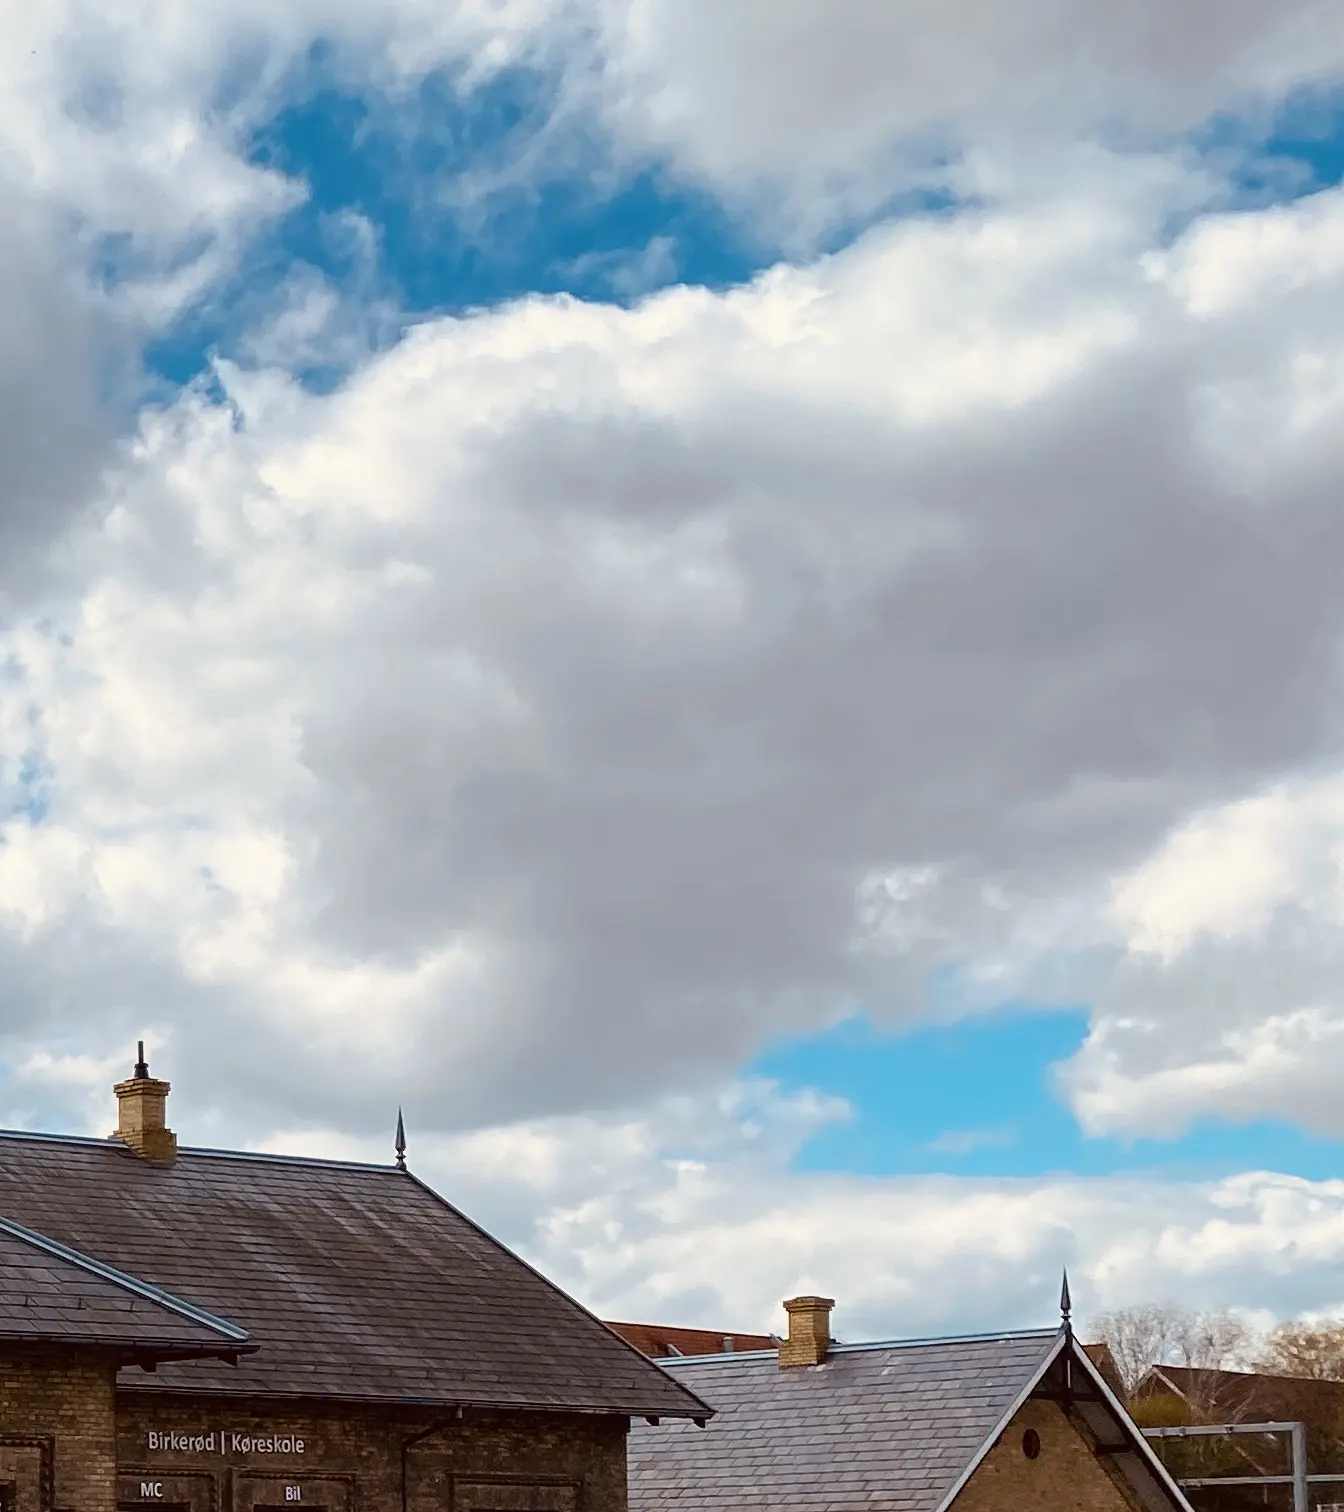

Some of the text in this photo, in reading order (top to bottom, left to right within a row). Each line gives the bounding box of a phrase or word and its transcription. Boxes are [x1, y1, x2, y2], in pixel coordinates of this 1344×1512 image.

[148, 1431, 215, 1453] Birkerød
[231, 1433, 305, 1454] Køreskole
[140, 1482, 163, 1498] MC
[285, 1485, 301, 1501] Bil
